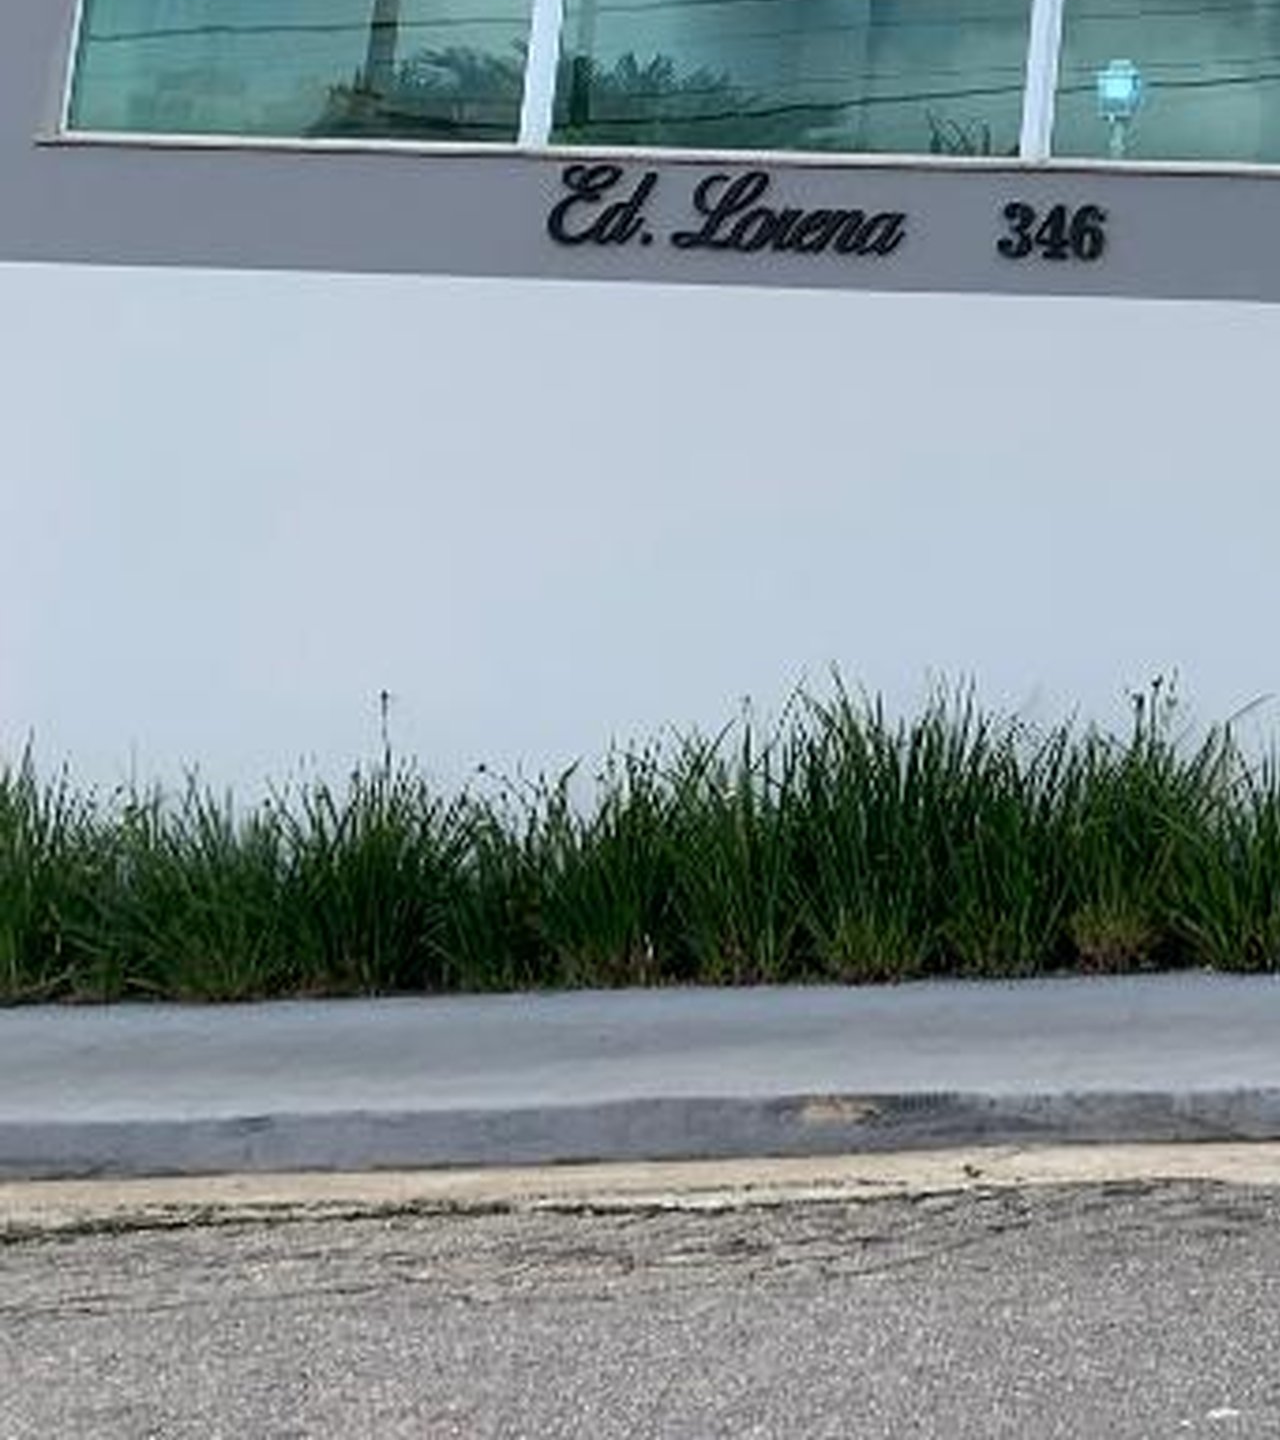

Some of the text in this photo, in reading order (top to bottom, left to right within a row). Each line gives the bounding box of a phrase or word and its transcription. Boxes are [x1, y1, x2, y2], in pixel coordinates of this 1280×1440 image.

[546, 164, 1106, 261] Ed. Lorena 346
